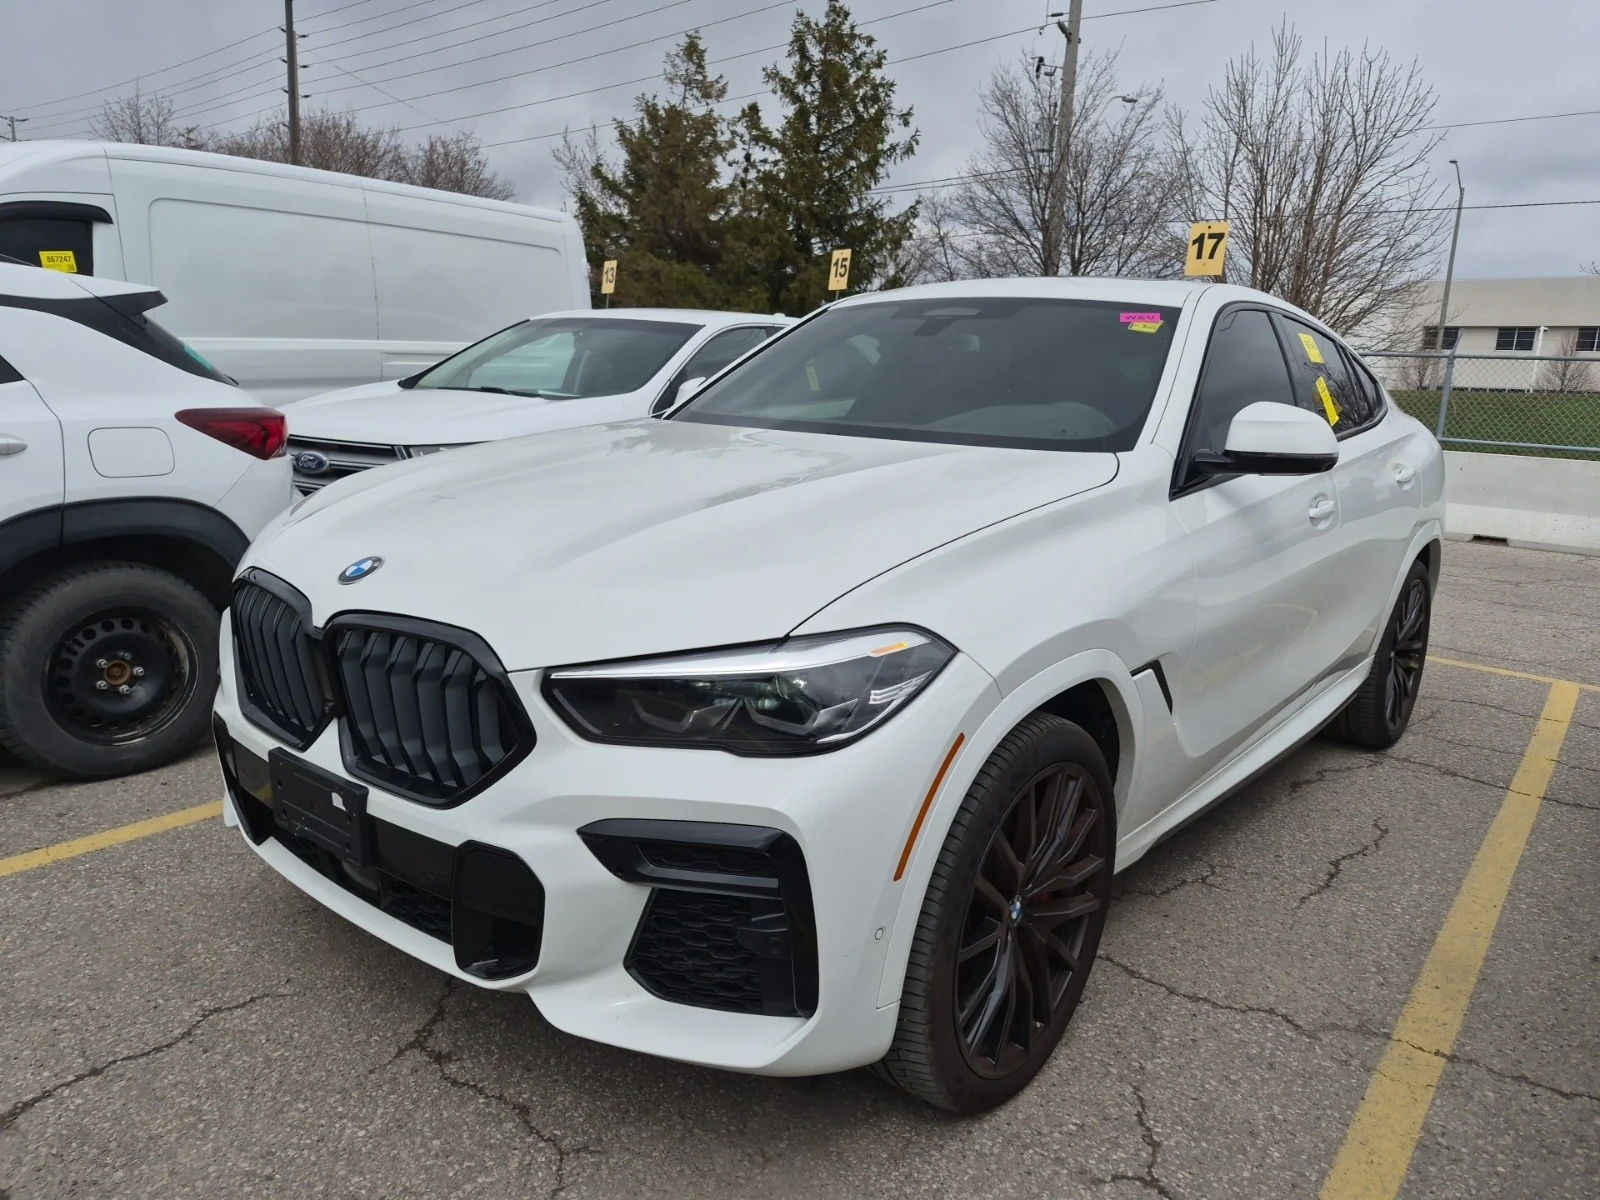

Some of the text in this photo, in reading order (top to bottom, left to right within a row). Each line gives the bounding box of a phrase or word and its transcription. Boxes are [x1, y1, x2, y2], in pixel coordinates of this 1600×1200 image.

[1192, 232, 1225, 259] 17
[605, 267, 614, 284] 13
[833, 257, 848, 278] 15
[298, 454, 318, 469] Ford
